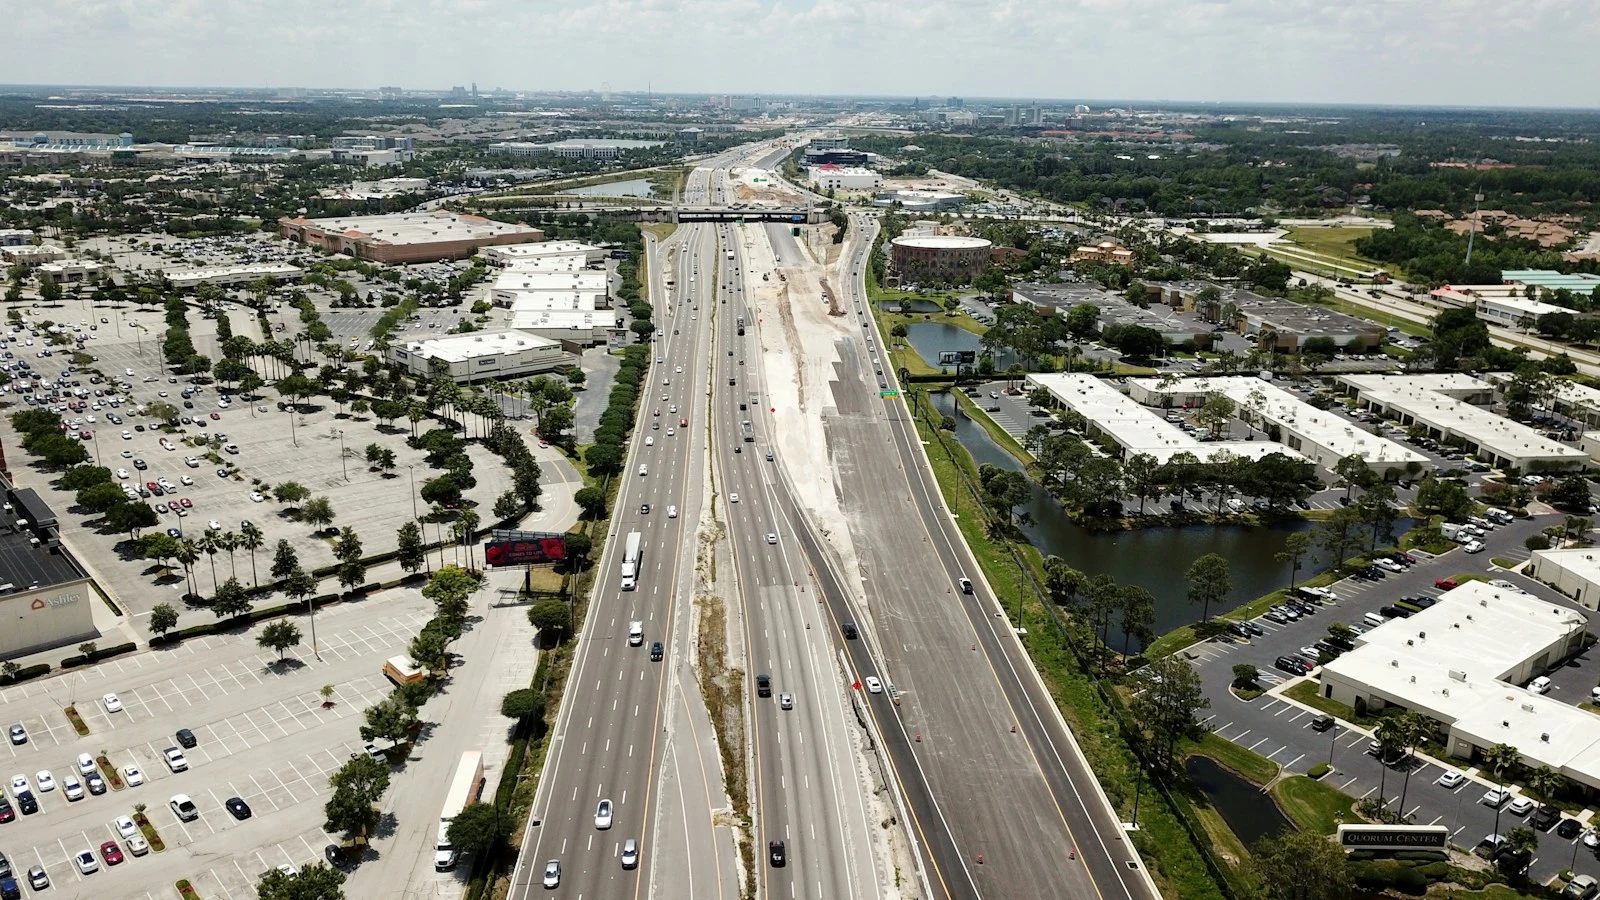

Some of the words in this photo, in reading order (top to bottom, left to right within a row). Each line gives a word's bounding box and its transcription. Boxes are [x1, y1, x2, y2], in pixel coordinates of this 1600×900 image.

[47, 593, 80, 606] Ashley
[1347, 833, 1392, 843] QUORUM
[1396, 834, 1438, 843] CENTER
